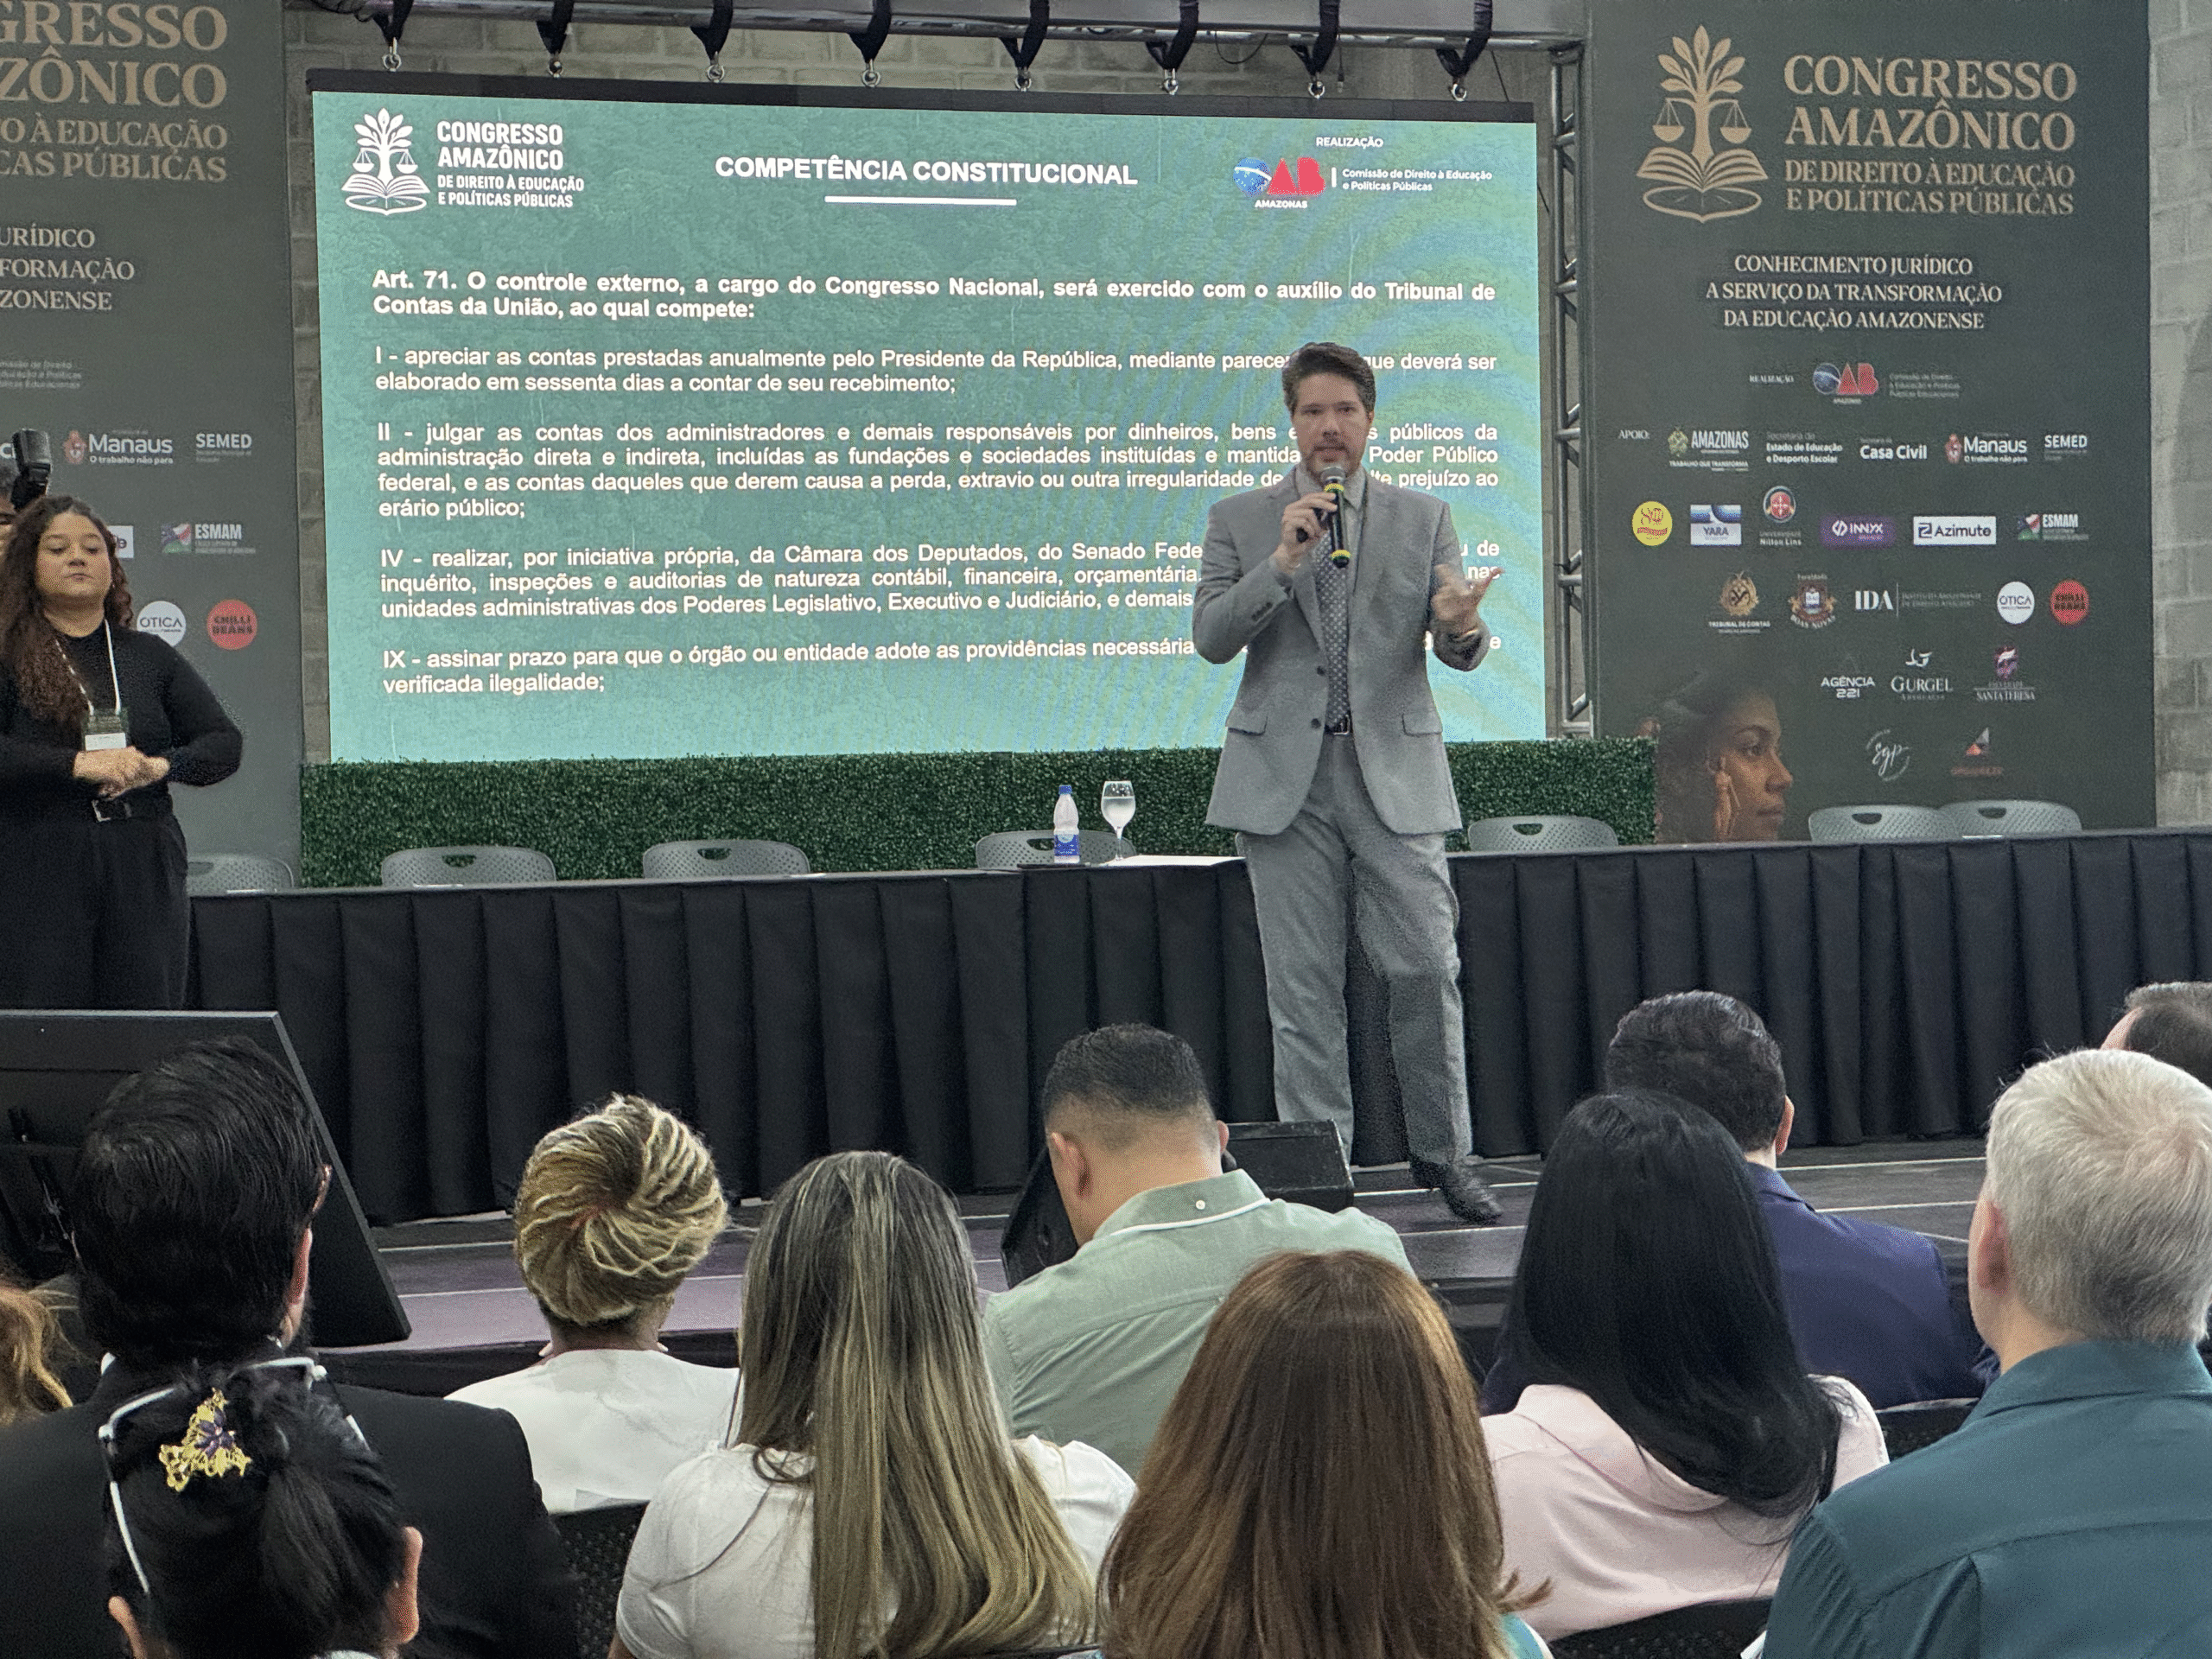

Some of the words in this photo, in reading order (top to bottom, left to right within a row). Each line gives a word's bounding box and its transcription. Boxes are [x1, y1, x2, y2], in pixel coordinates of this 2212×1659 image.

[1783, 54, 2076, 102] CONGRESSO
[29, 111, 53, 143] À
[57, 118, 228, 156] EDUCAÇÃO
[436, 120, 563, 146] CONGRESSO
[1785, 98, 2075, 151] AMAZÔNICO
[1315, 136, 1384, 149] REALIZAÇÃO
[62, 146, 227, 182] PÚBLICAS
[437, 143, 564, 171] AMAZÔNICO
[715, 154, 908, 181] COMPETÊNCIA
[912, 161, 1139, 186] CONSTITUCIONAL
[1342, 168, 1389, 179] Comissão
[1389, 168, 1403, 179] de
[1403, 168, 1437, 179] Direito
[1437, 169, 1445, 180] à
[1446, 169, 1493, 182] Educação
[1785, 160, 1815, 183] DE
[1821, 160, 1922, 185] DIREITO
[1925, 157, 1943, 185] À
[1945, 161, 2075, 191] EDUCAÇÃO
[437, 174, 454, 188] DE
[456, 175, 505, 190] DIREITO
[505, 174, 517, 190] À
[518, 175, 585, 194] EDUCAÇÃO
[1351, 181, 1391, 191] Políticas
[1392, 181, 1433, 192] Públicas
[437, 191, 447, 206] E
[448, 189, 512, 207] POLÍTICAS
[513, 191, 574, 208] PÚBLICAS
[1254, 199, 1308, 210] AMAZONAS
[1787, 188, 1802, 210] E
[1808, 184, 1944, 213] POLÍTICAS
[1949, 187, 2075, 215] PÚBLICAS
[1734, 254, 1887, 274] CONHECIMENTO
[1891, 254, 1973, 276] JURÍDICO
[372, 269, 414, 289] Art.
[423, 270, 457, 290] 71.
[467, 270, 486, 290] O
[495, 271, 588, 292] controle
[596, 273, 686, 296] externo,
[695, 277, 709, 294] a
[717, 278, 779, 298] cargo
[787, 275, 817, 295] do
[824, 276, 940, 299] Congresso
[949, 276, 1045, 300] Nacional,
[1052, 277, 1099, 297] será
[1106, 279, 1195, 298] exercido
[1202, 283, 1246, 299] com
[1254, 284, 1268, 299] o
[1276, 280, 1343, 300] auxílio
[1350, 282, 1376, 300] do
[1383, 282, 1464, 301] Tribunal
[1471, 283, 1496, 301] de
[1706, 283, 1719, 298] A
[1722, 282, 1803, 303] SERVIÇO
[1806, 284, 1831, 300] DA
[1834, 283, 2003, 305] TRANSFORMAÇÃO
[372, 295, 454, 315] Contas
[459, 296, 488, 315] da
[493, 296, 564, 320] União,
[569, 302, 598, 317] ao
[602, 298, 650, 321] qual
[655, 299, 755, 322] compete:
[1724, 309, 1749, 327] DA
[1752, 308, 1853, 331] EDUCAÇÃO
[1856, 311, 1984, 329] AMAZONENSE
[375, 371, 481, 391] elaborado
[486, 376, 520, 391] em
[524, 373, 618, 391] sessenta
[622, 372, 665, 392] dias
[670, 377, 683, 391] a
[689, 374, 753, 392] contar
[756, 372, 783, 392] de
[787, 377, 824, 392] seu
[830, 373, 956, 395] recebimento;
[88, 433, 173, 454] Manaus
[195, 433, 252, 449] SEMED
[1691, 430, 1750, 449] AMAZONAS
[1766, 442, 1793, 452] Estado
[1794, 442, 1804, 451] de
[1805, 442, 1843, 454] Educação
[1963, 435, 2028, 454] Manaus
[2044, 434, 2088, 448] SEMED
[99, 454, 135, 464] trabalho
[137, 455, 152, 465] não
[154, 456, 173, 466] para
[1766, 454, 1772, 463] e
[1859, 444, 1894, 460] Casa
[1896, 444, 1928, 460] Civil
[378, 498, 441, 517] erário
[445, 498, 525, 522] público;
[2042, 513, 2079, 528] ESMAM
[194, 524, 242, 539] ESMAM
[1703, 526, 1729, 536] YARA
[1855, 590, 1894, 611] IDA
[383, 650, 406, 669] IX
[426, 649, 504, 668] assinar
[508, 651, 567, 671] prazo
[573, 650, 619, 670] para
[624, 649, 664, 669] que
[669, 649, 683, 664] o
[688, 645, 747, 668] órgão
[752, 647, 778, 663] ou
[783, 642, 869, 662] entidade
[874, 641, 931, 660] adote
[936, 644, 960, 659] as
[966, 639, 1087, 663] providências
[1092, 637, 1195, 657] necessária
[382, 673, 484, 694] verificada
[489, 671, 605, 696] ilegalidade;
[1821, 675, 1876, 688] AGÊNCIA
[1891, 676, 1955, 692] GURGEL
[1836, 688, 1860, 698] 221
